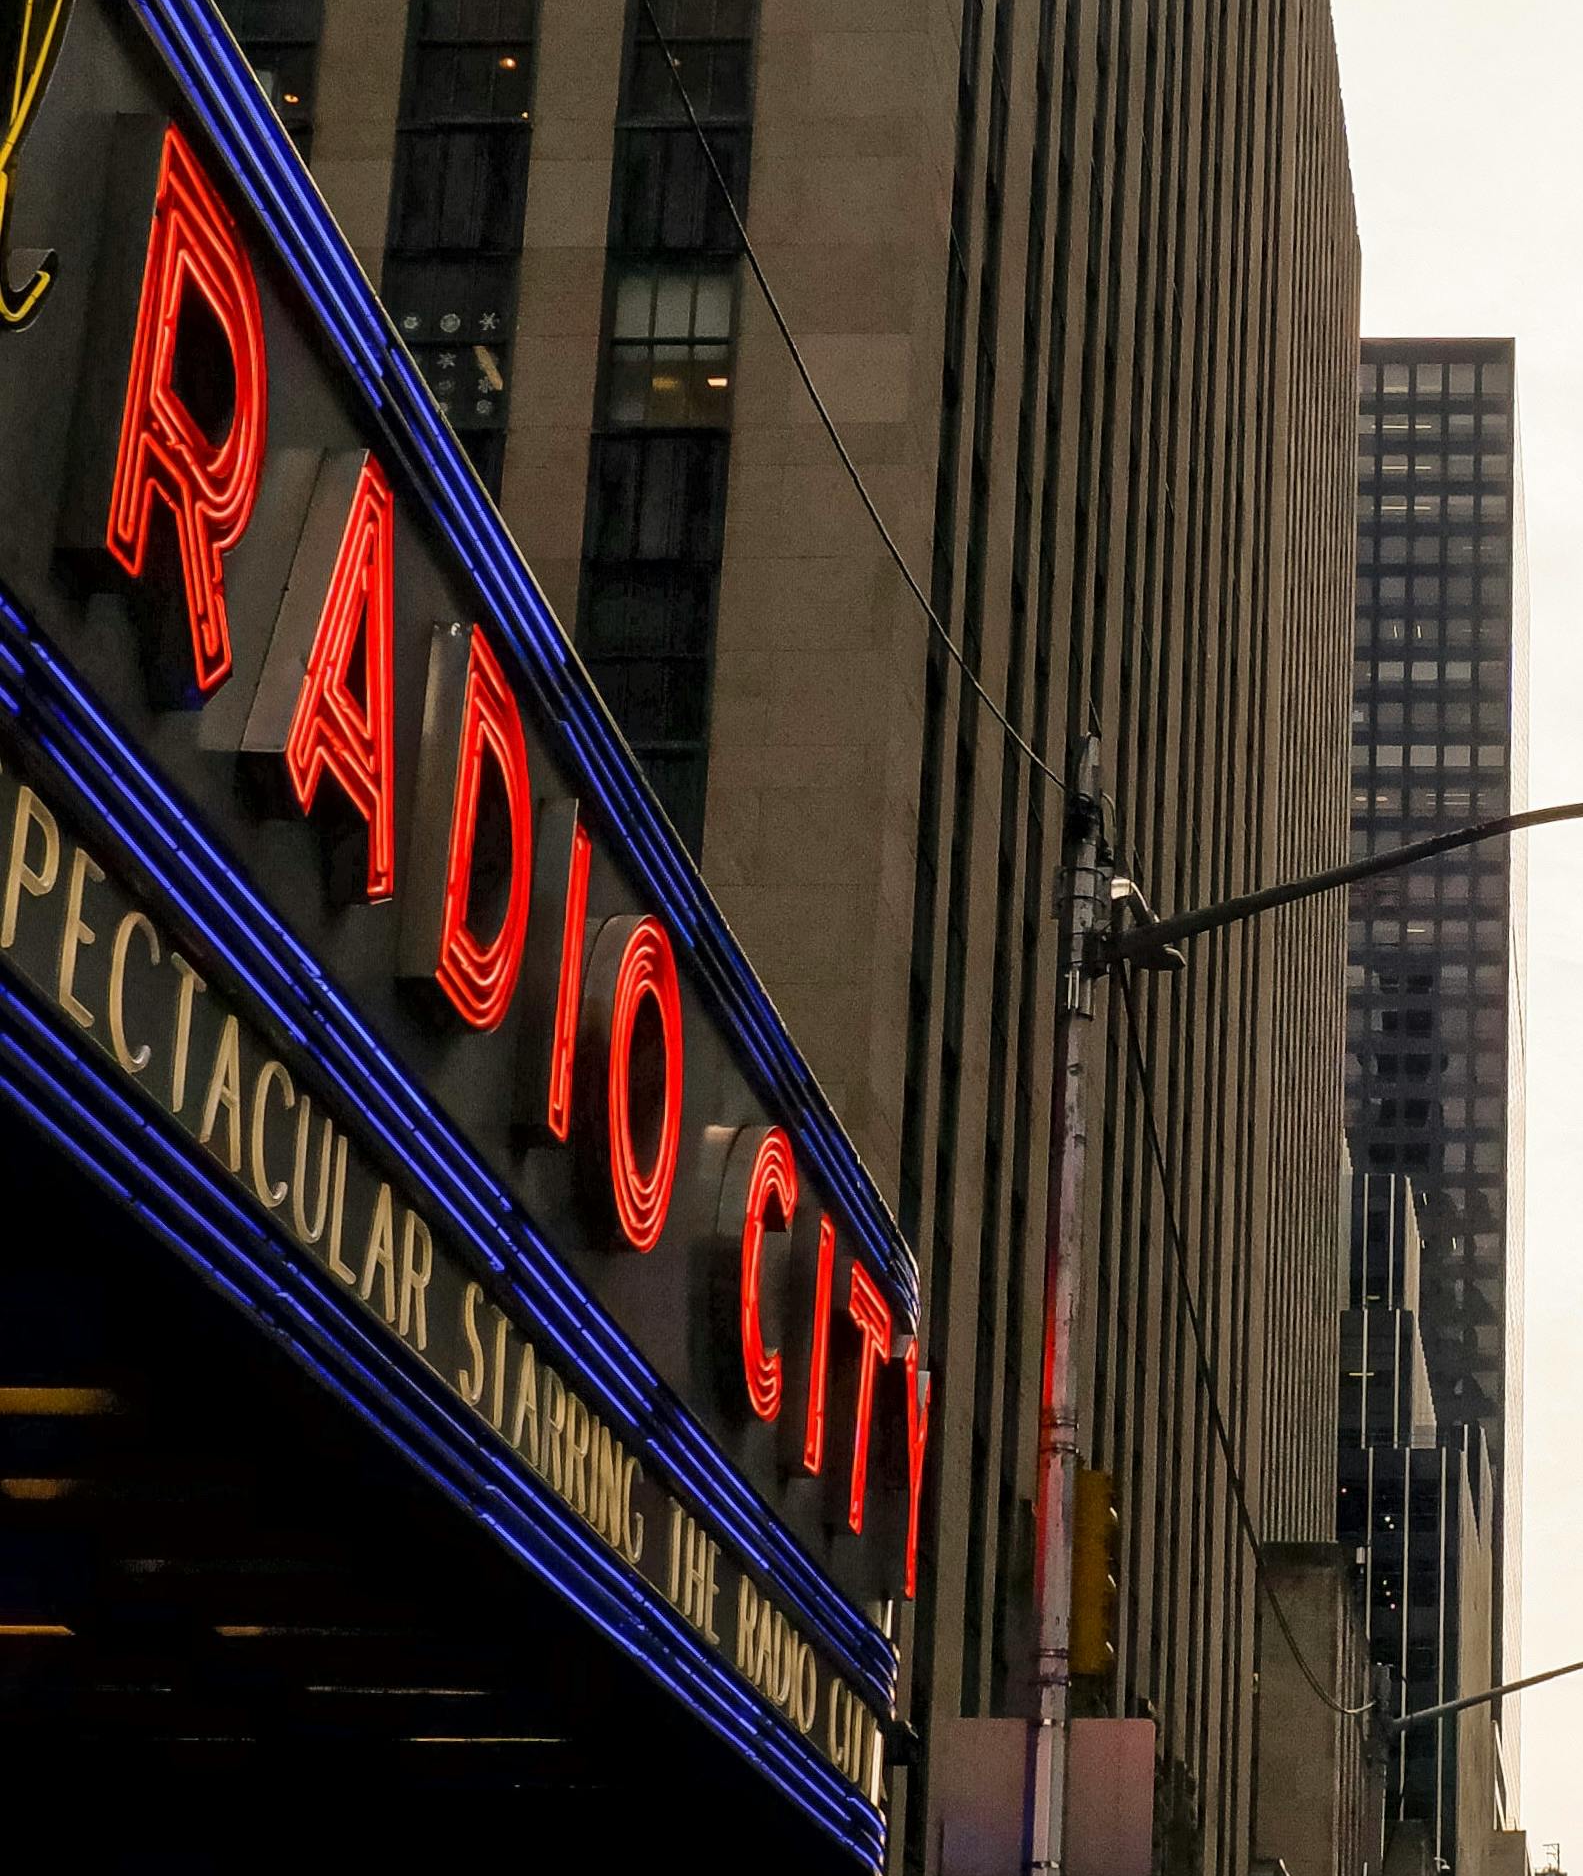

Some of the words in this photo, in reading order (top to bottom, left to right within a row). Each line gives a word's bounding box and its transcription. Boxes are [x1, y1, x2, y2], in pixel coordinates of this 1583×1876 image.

[0, 759, 432, 1353] PECTACULAR
[458, 1281, 647, 1565] STARRING
[668, 1496, 721, 1646] THE
[736, 1573, 818, 1734] RADIO
[106, 123, 684, 1254] RADIO
[741, 1127, 931, 1600] CITY
